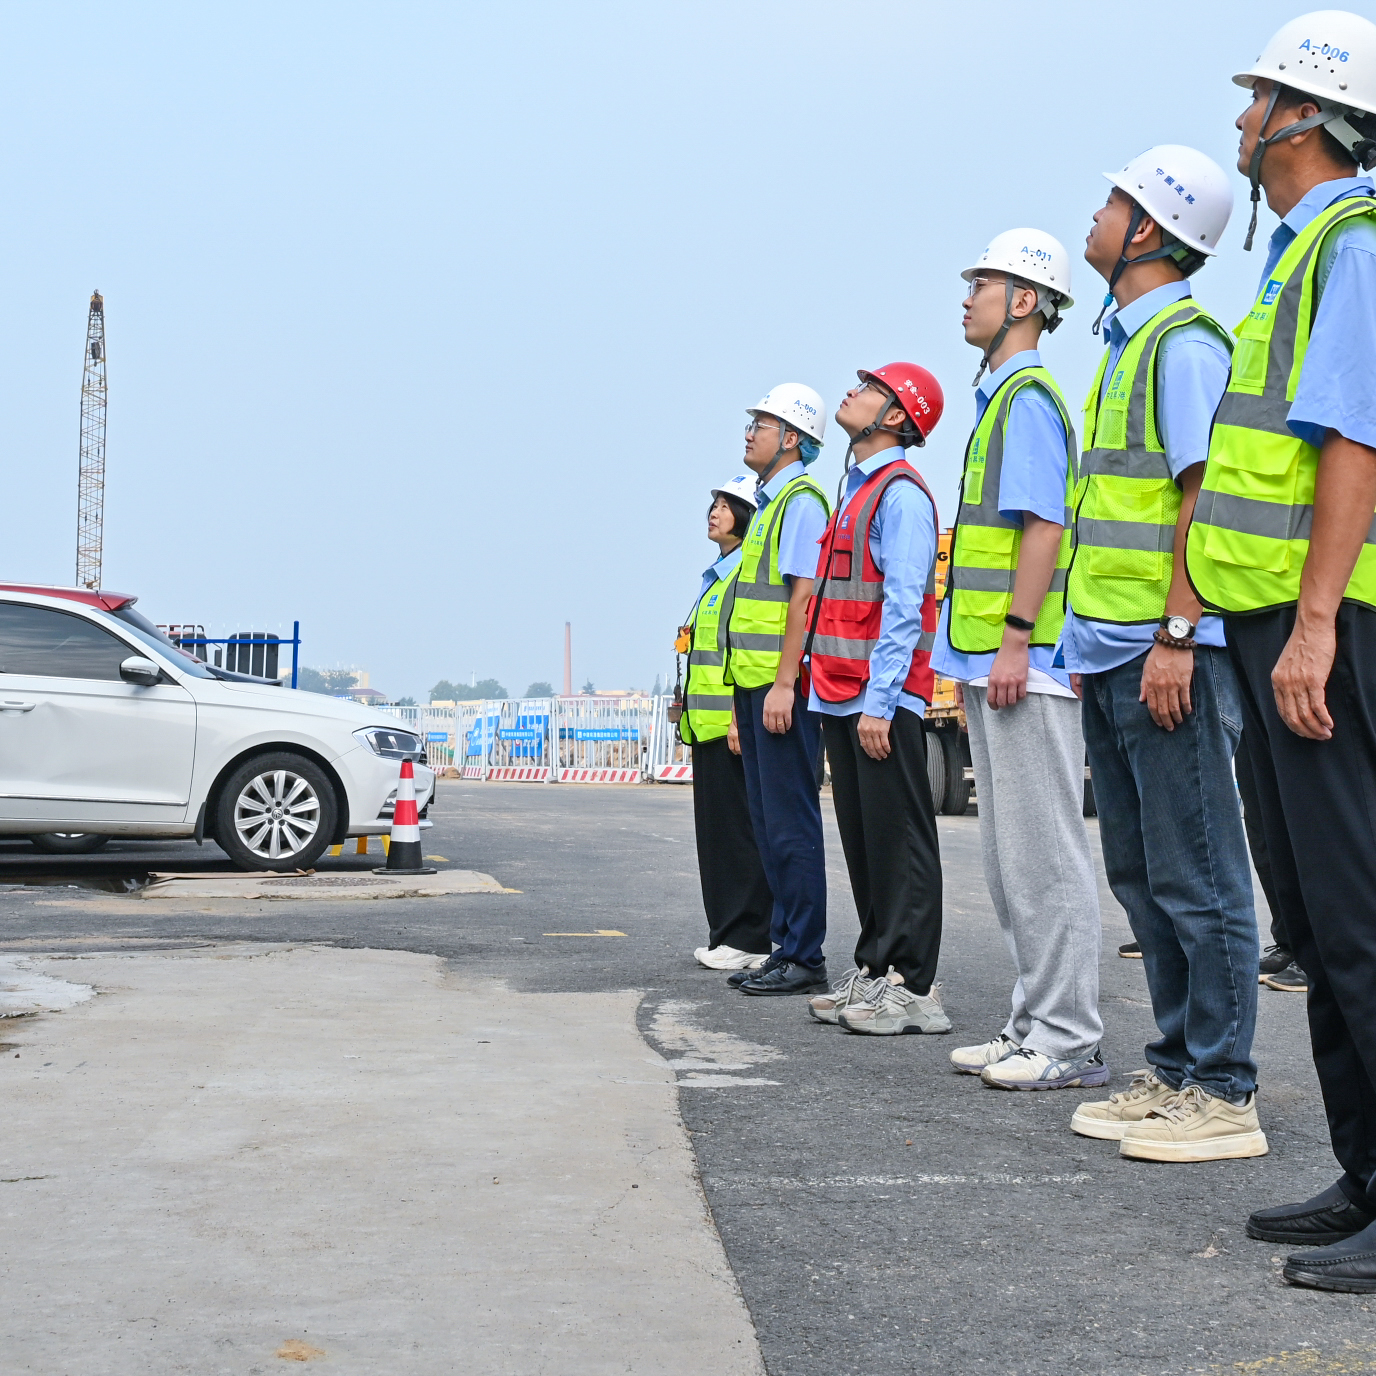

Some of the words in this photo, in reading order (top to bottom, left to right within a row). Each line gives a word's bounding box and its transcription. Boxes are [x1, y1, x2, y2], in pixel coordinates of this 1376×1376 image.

[1298, 38, 1350, 63] A-006
[1021, 246, 1052, 262] A-011
[904, 379, 931, 415] 安全-003
